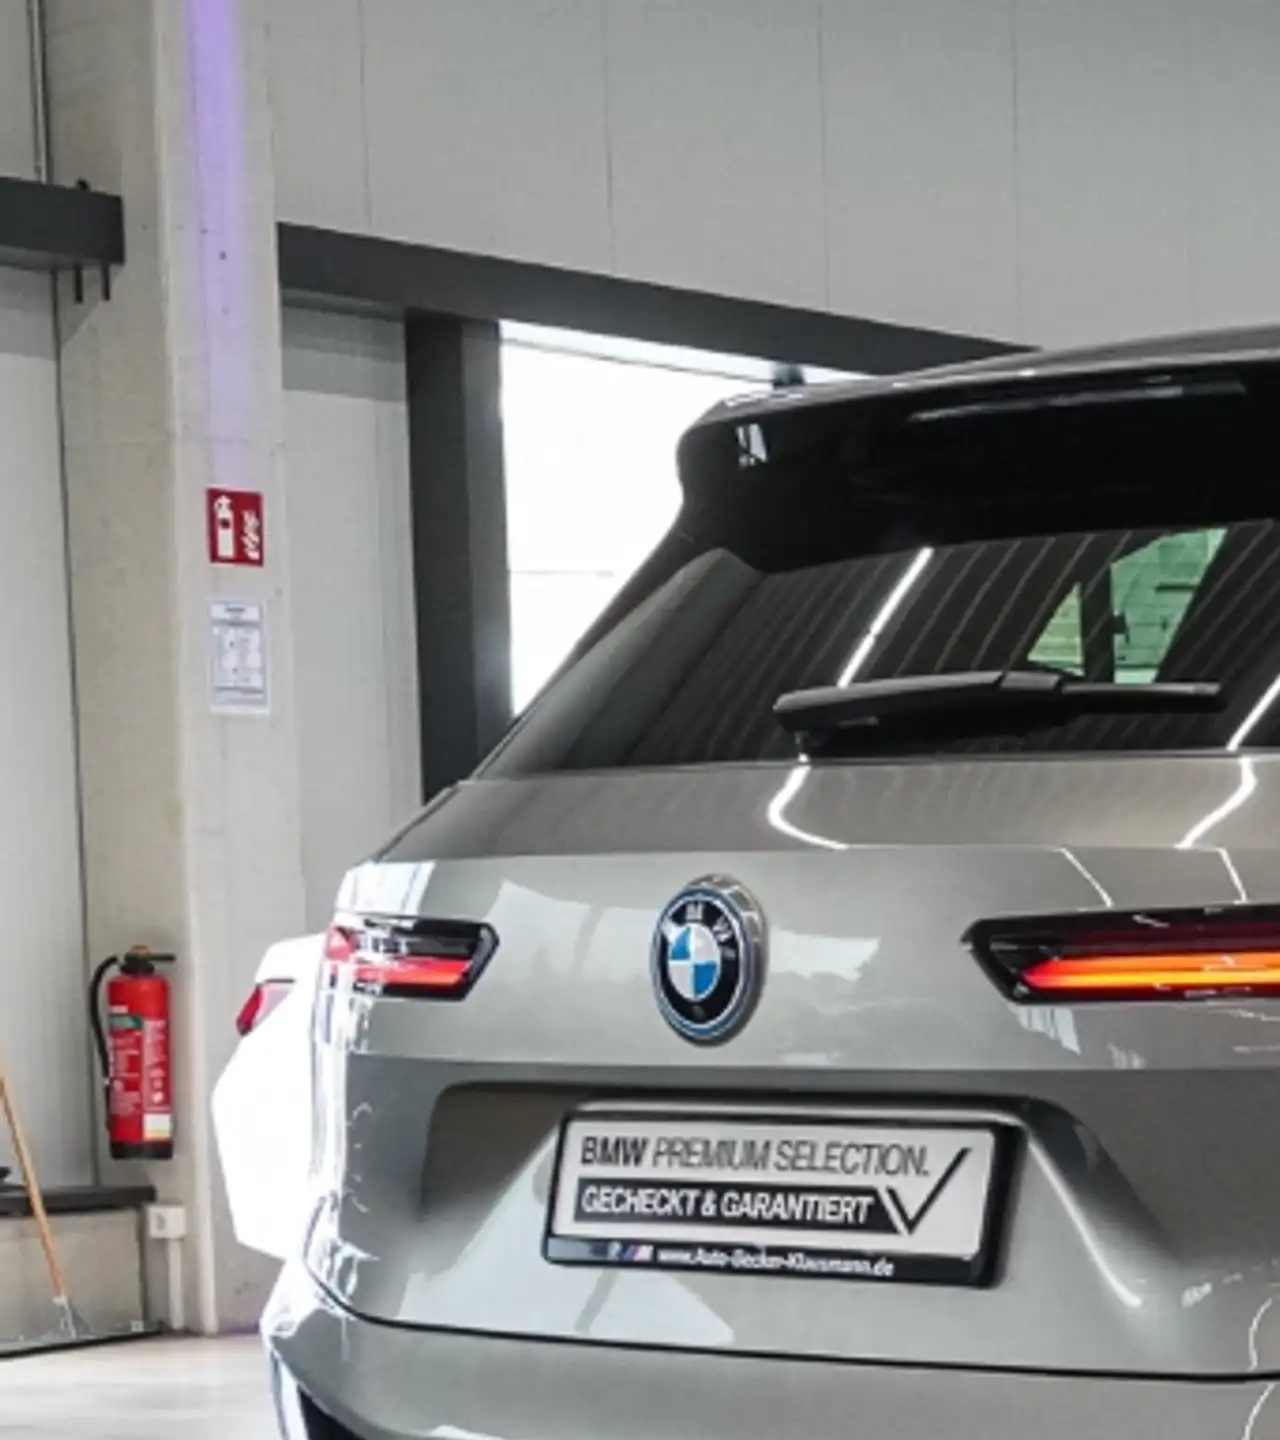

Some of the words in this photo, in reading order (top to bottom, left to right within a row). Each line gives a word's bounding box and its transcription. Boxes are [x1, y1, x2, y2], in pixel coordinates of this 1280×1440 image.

[580, 1136, 649, 1165] BMW
[653, 1137, 770, 1171] PREMIUM
[774, 1139, 930, 1176] SELECTION.
[581, 1184, 700, 1214] GECHECKT
[701, 1190, 717, 1216] &
[721, 1191, 874, 1224] GARANTIERT
